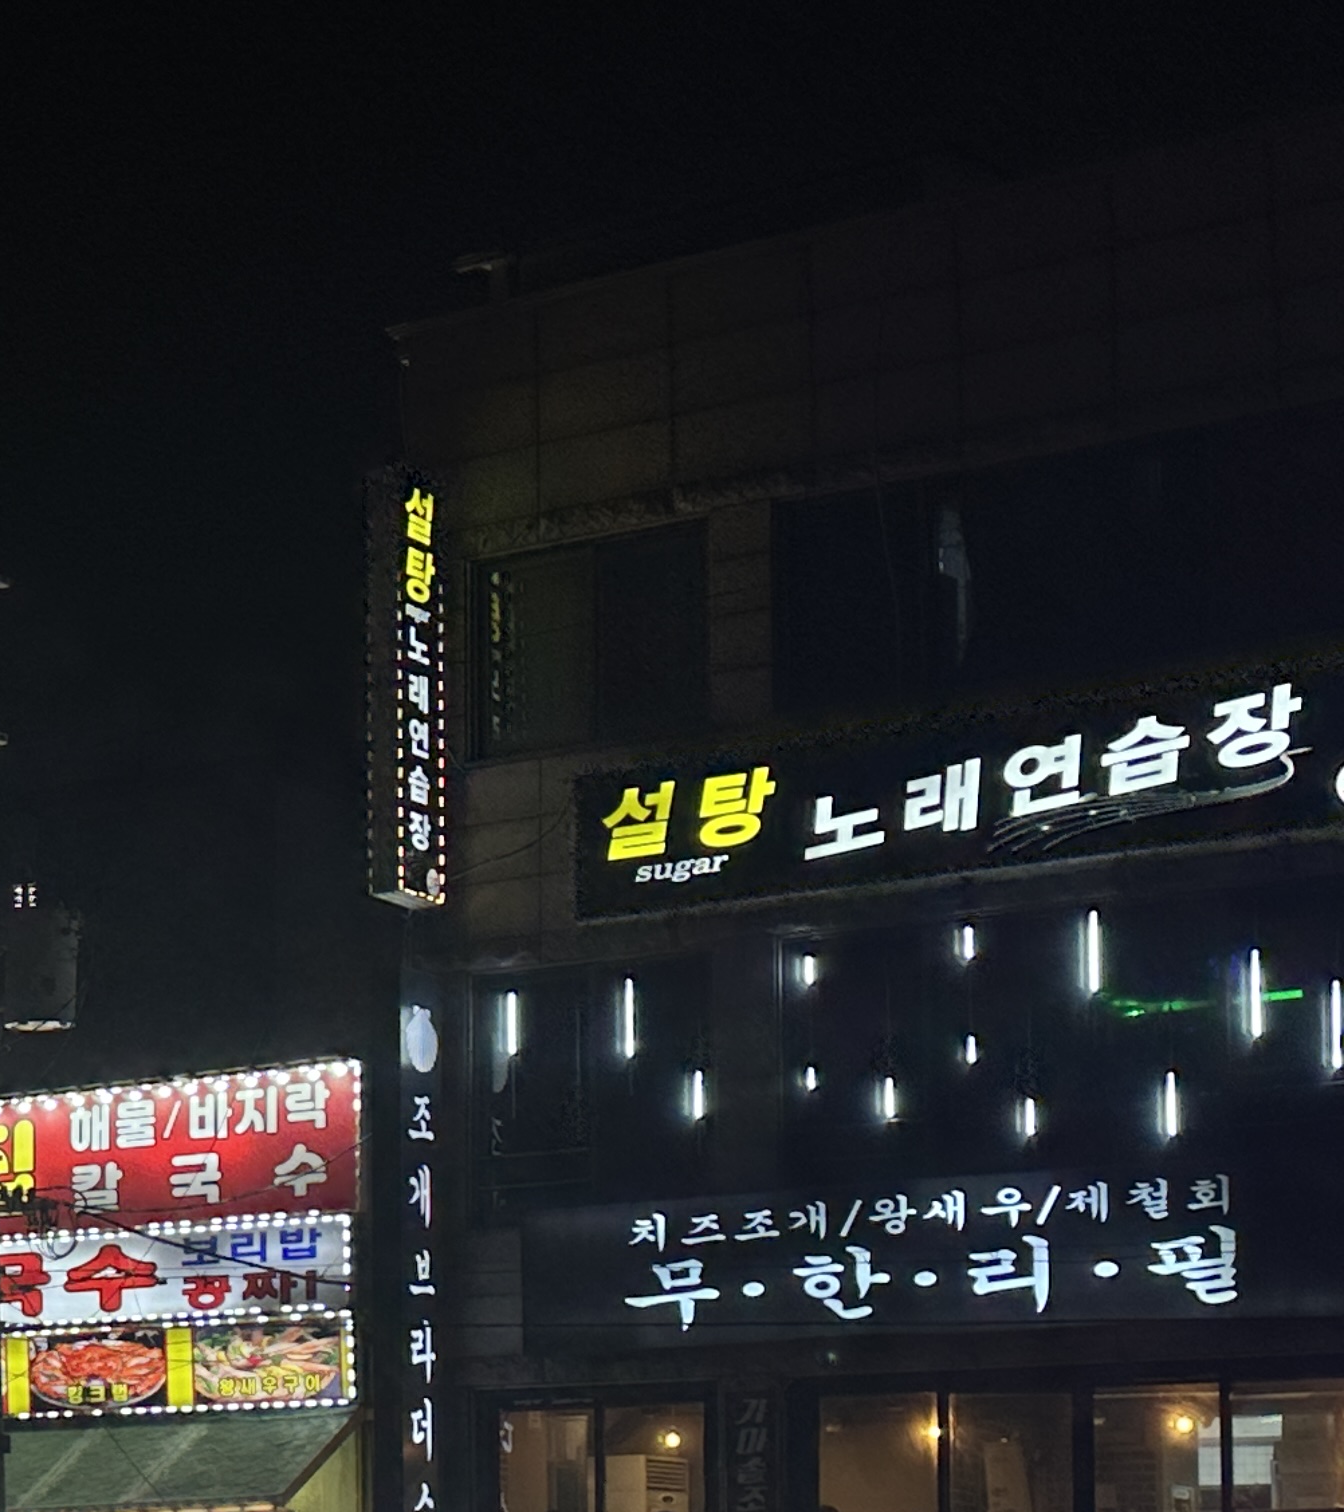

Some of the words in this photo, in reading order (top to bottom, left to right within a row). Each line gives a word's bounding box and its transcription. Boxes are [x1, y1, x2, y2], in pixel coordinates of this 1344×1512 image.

[405, 487, 435, 604] 설탕
[407, 625, 432, 852] 노래연습장
[601, 766, 776, 862] 설탕
[804, 682, 1303, 861] 노래연습장
[635, 851, 729, 884] sugar
[70, 1080, 331, 1153] 해물/바지락
[71, 1143, 328, 1215] 칼국수
[181, 1228, 322, 1267] 보리밥
[67, 1384, 129, 1405] 킹크랩
